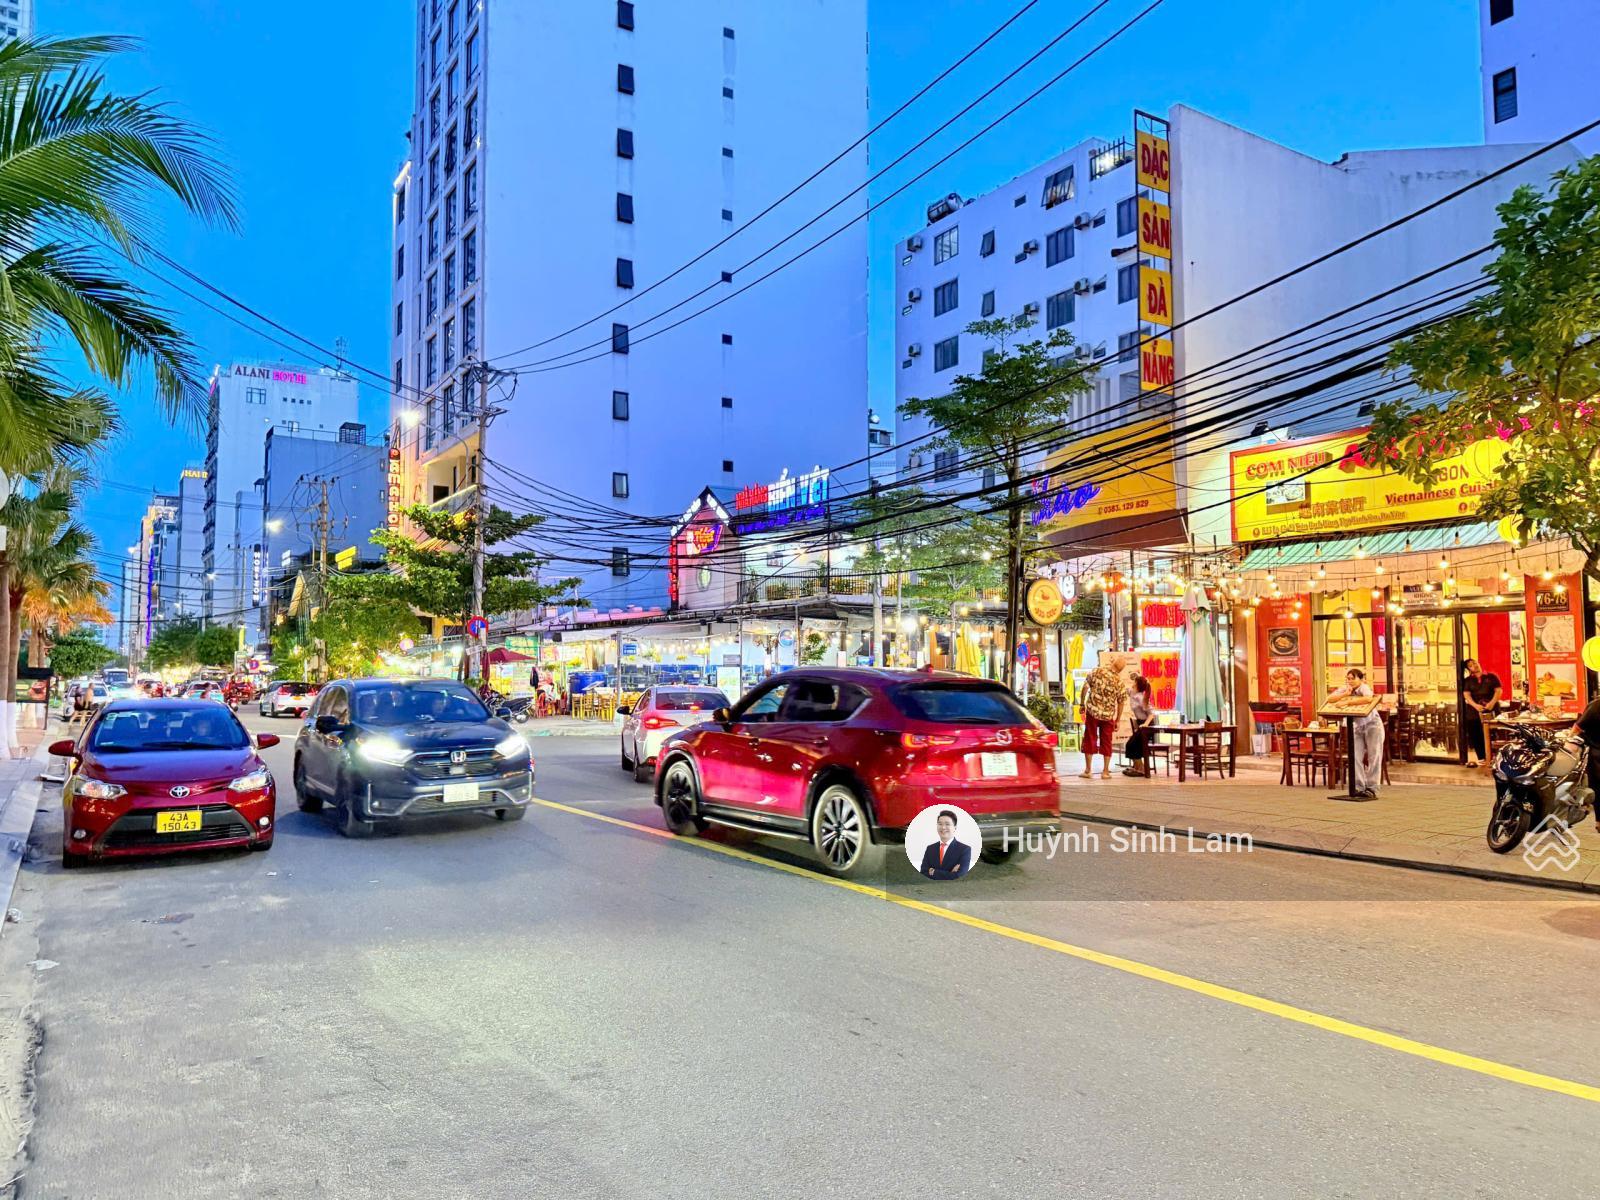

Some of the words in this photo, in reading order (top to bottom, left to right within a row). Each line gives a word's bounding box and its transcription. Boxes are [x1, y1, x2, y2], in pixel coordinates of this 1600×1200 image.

[1141, 139, 1168, 184] ĐẶC
[1143, 204, 1170, 249] SẢN
[1147, 277, 1167, 317] ĐÀ
[235, 364, 270, 379] ALANI
[1385, 487, 1456, 504] Vietnamese
[1538, 592, 1567, 605] 76-78
[170, 812, 188, 822] 43A
